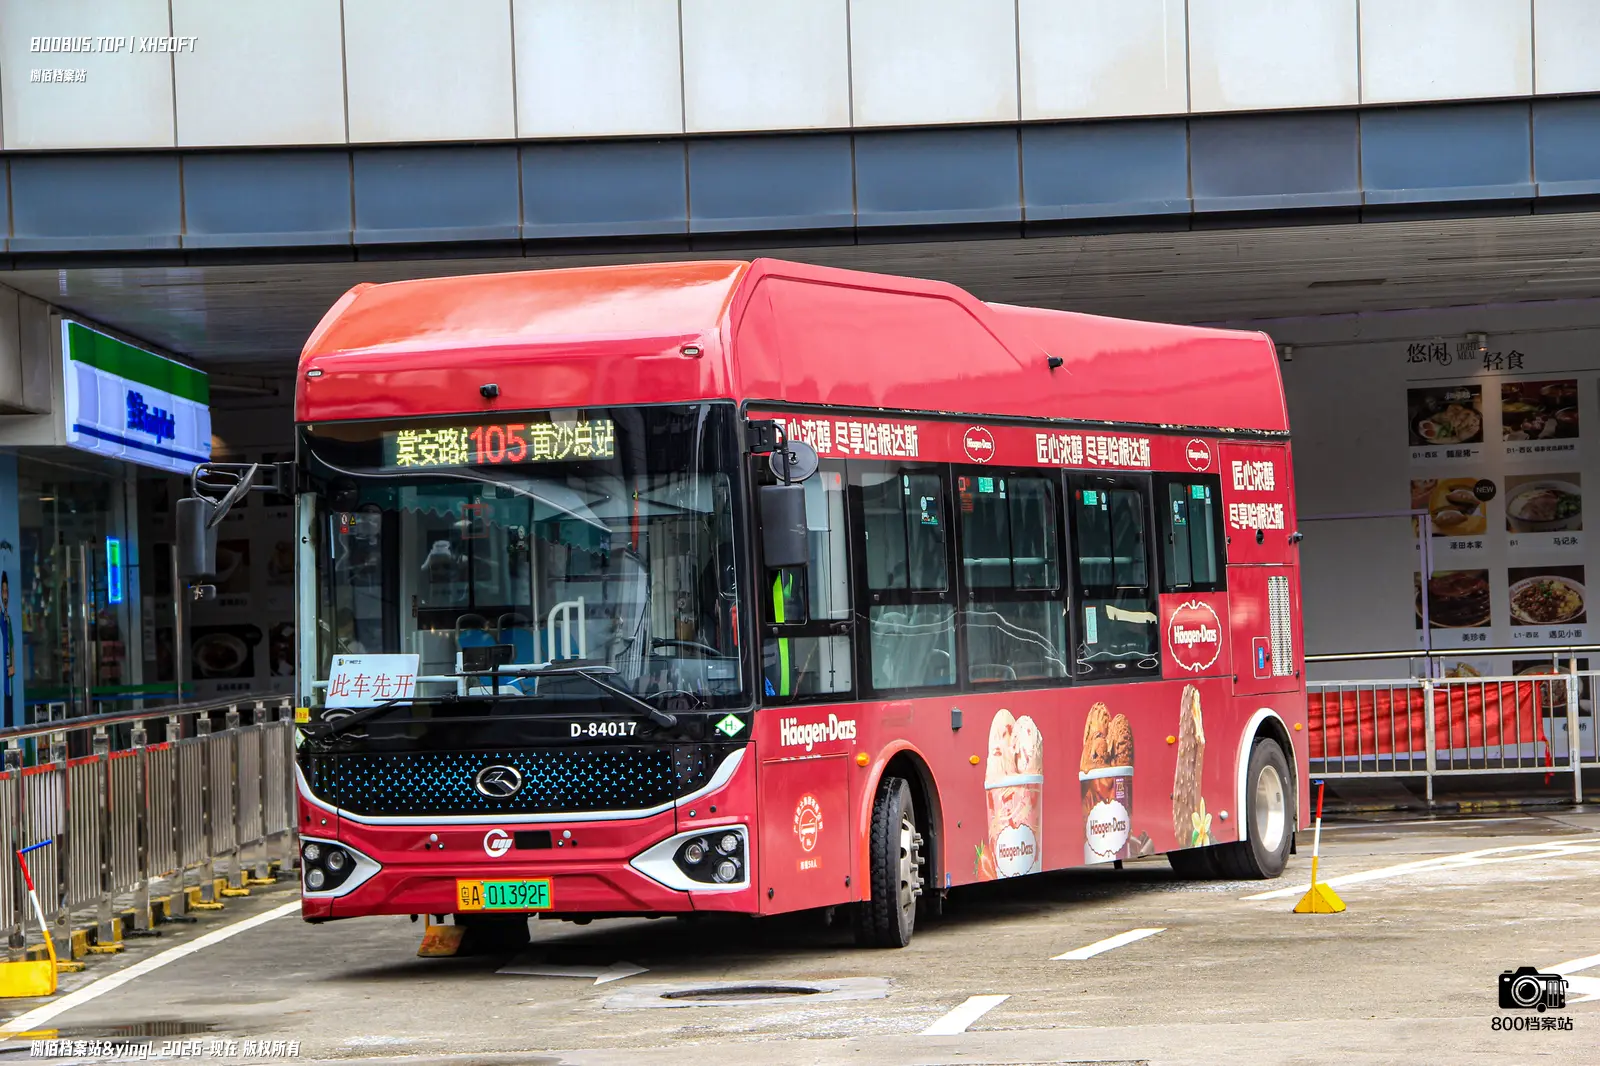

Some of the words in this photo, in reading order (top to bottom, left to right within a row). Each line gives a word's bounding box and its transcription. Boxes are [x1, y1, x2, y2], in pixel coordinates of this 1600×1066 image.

[1407, 342, 1447, 364] 悠闲
[1483, 350, 1524, 371] 轻食
[469, 424, 527, 464] 105
[531, 419, 615, 460] 黄沙总站
[835, 421, 919, 457] 尽享哈根达斯
[1035, 433, 1083, 465] 匠心浓醇
[1086, 436, 1151, 467] 尽享哈根达斯
[1231, 460, 1275, 491] 匠心浓醇
[1476, 485, 1495, 494] NEW
[1229, 503, 1285, 530] 尽享哈根达斯
[1553, 537, 1578, 546] 马记永
[1174, 624, 1217, 649] Häagen-Dazs
[1462, 633, 1486, 642] 美珍香
[329, 673, 413, 699] 此车先开
[570, 721, 637, 738] D-84017
[780, 713, 857, 752] Häagen-Dazs
[1089, 817, 1126, 838] Häagen-Dazs
[461, 886, 480, 905] 粤A
[488, 884, 546, 905] 01392F
